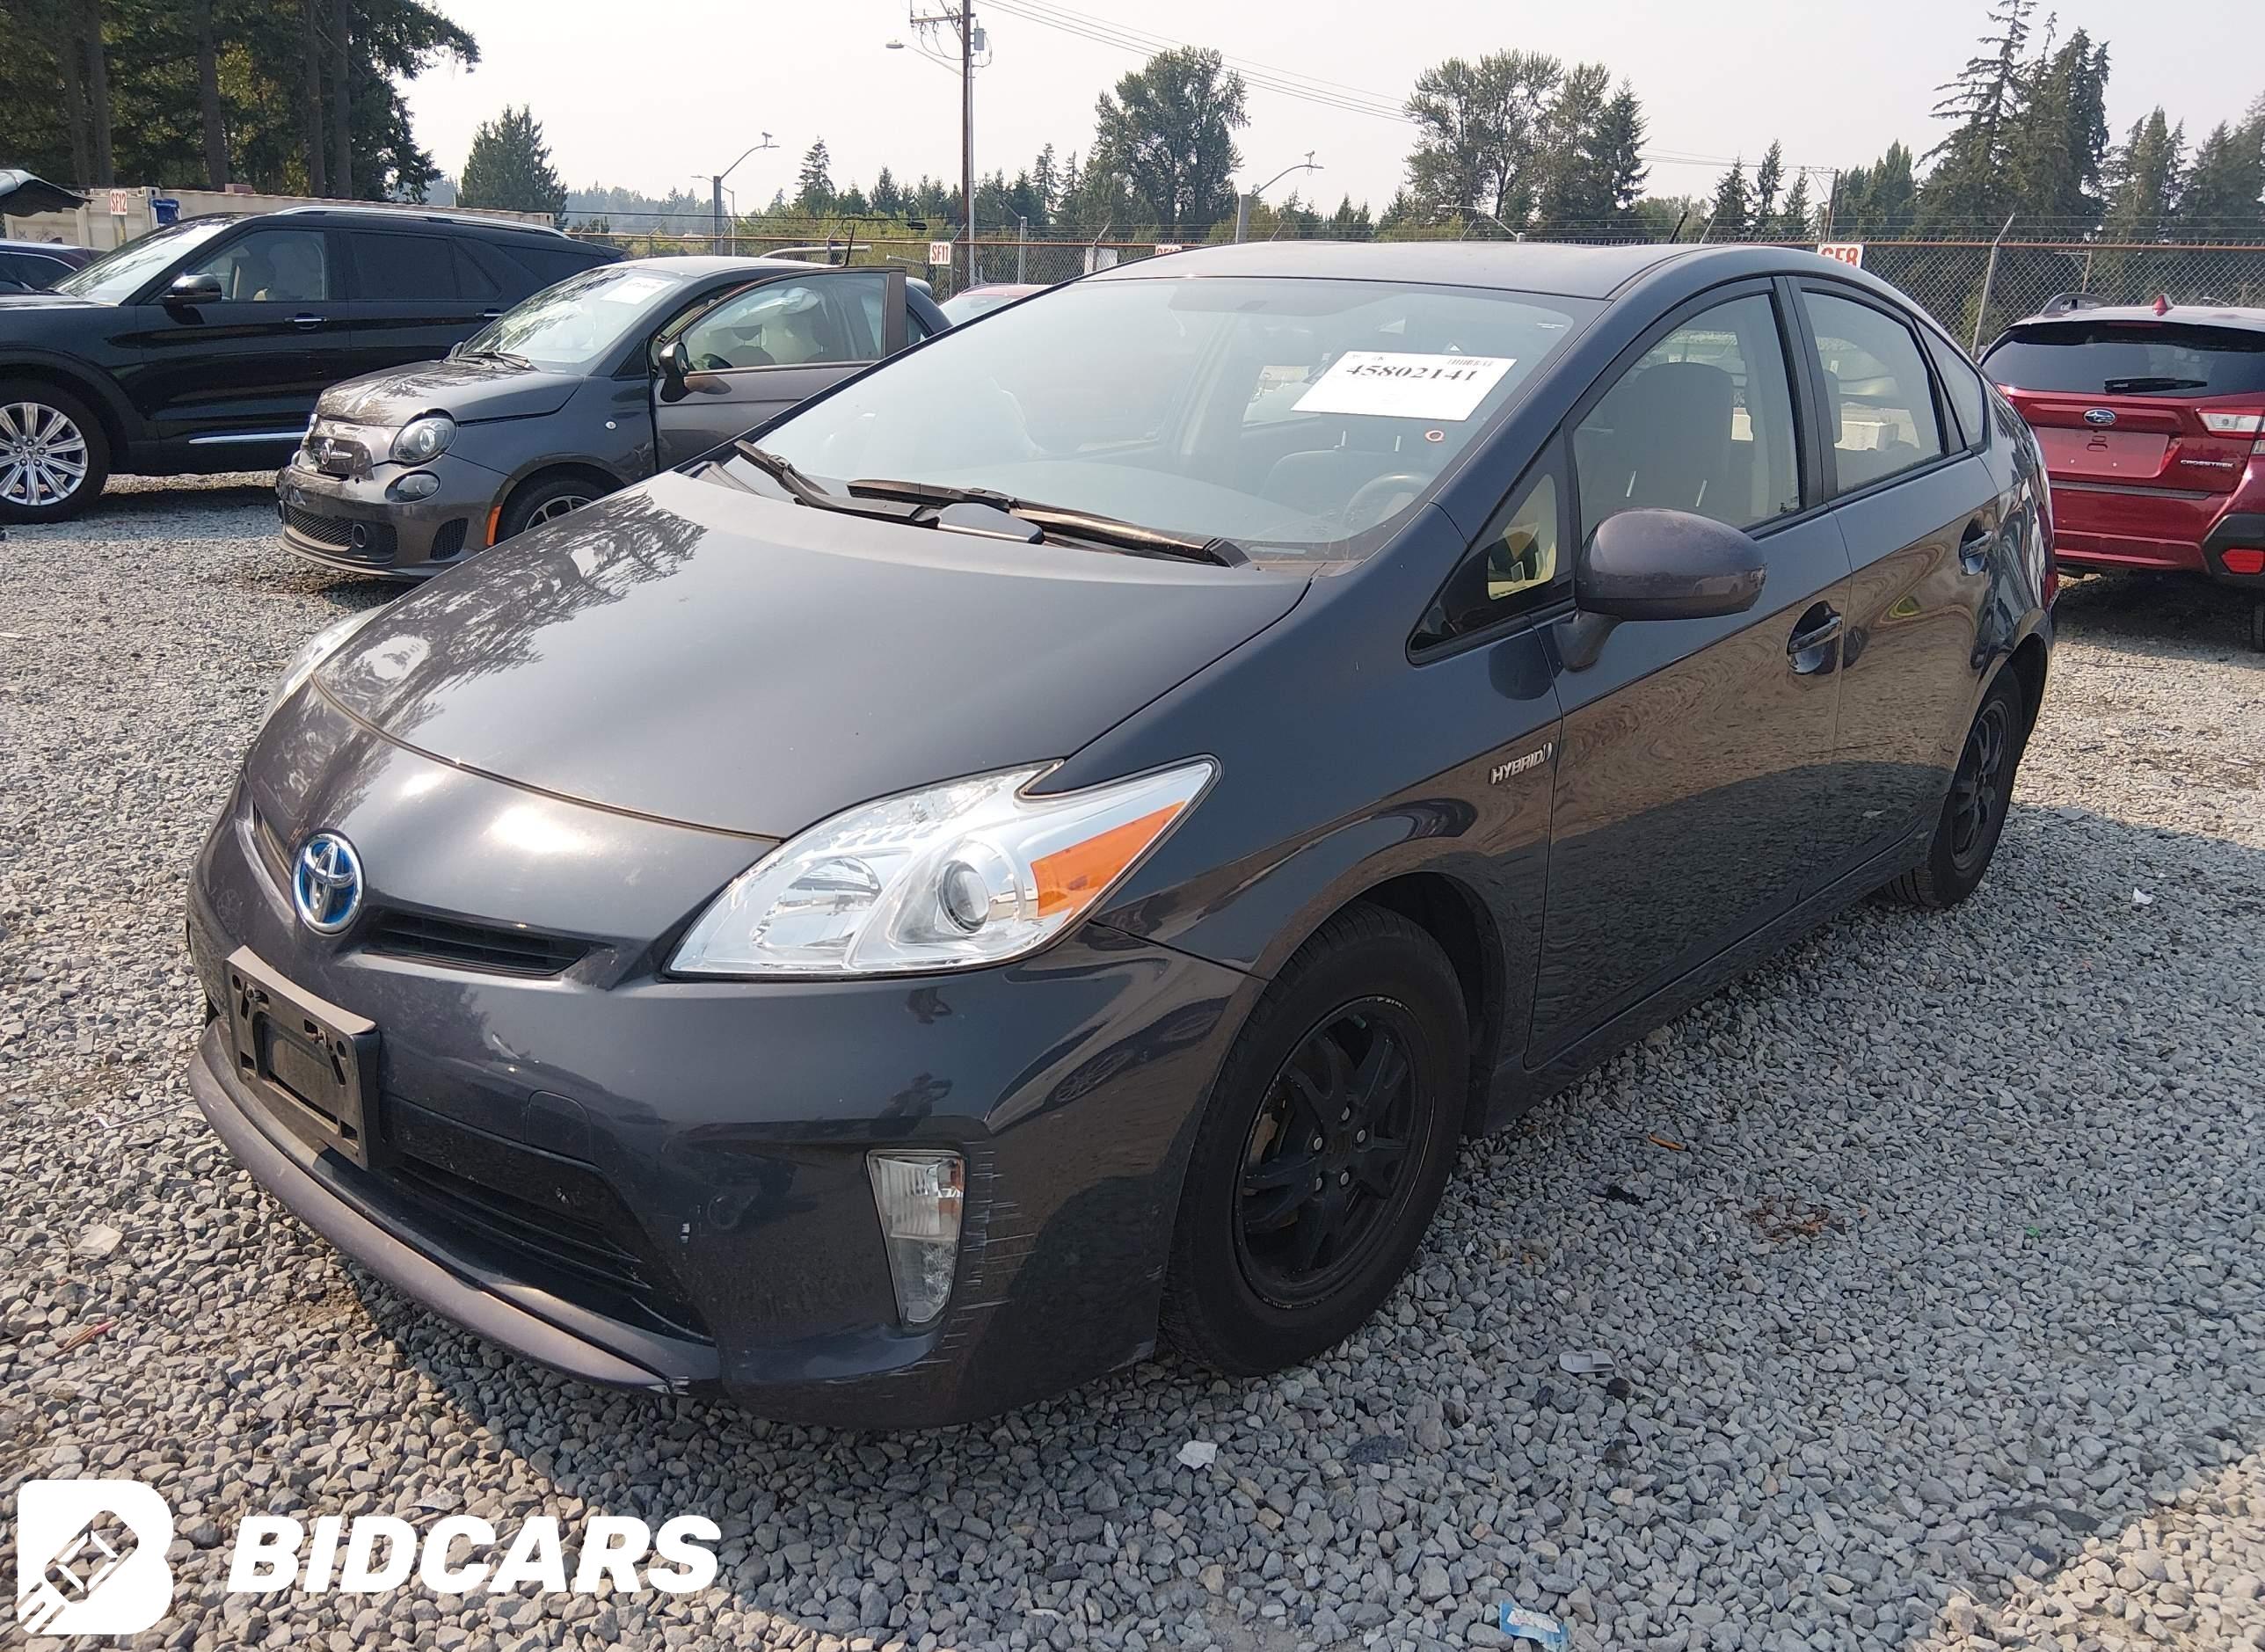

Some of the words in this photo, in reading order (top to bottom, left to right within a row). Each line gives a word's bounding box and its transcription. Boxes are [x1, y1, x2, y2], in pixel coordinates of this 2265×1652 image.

[111, 193, 127, 212] SF12
[932, 244, 949, 262] SF11
[1347, 364, 1478, 381] 45802141
[1491, 749, 1544, 784] HYBRID
